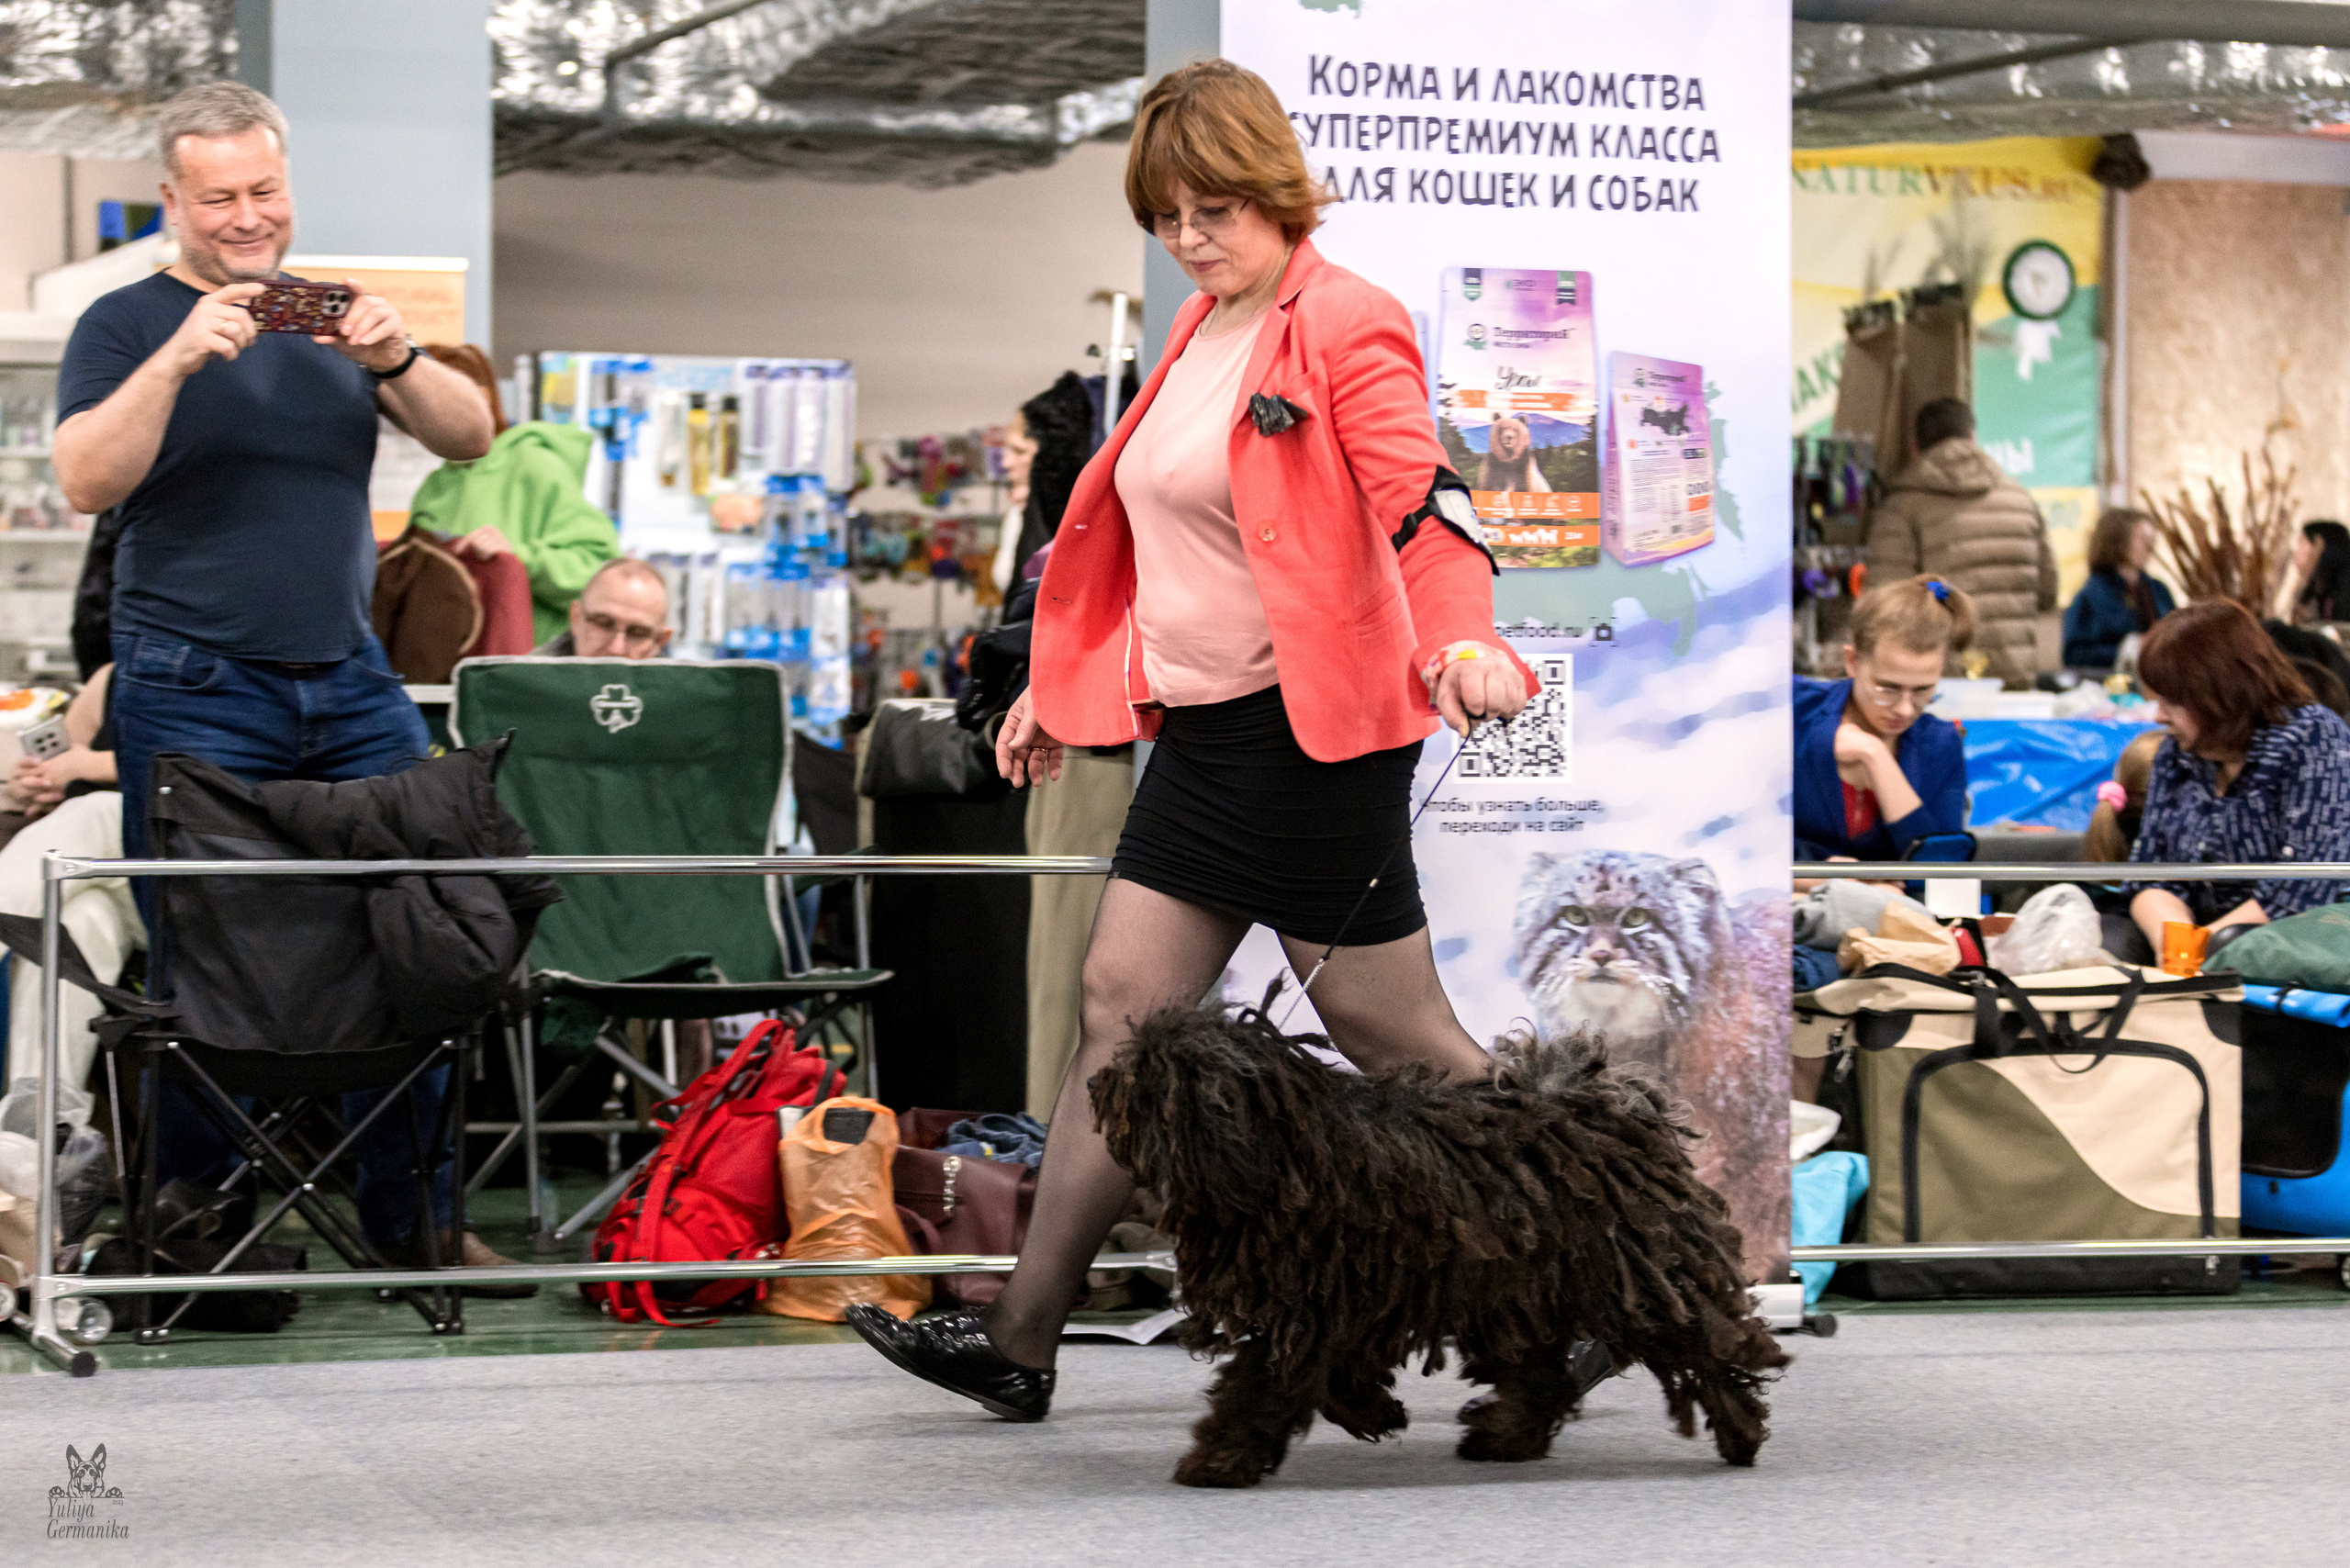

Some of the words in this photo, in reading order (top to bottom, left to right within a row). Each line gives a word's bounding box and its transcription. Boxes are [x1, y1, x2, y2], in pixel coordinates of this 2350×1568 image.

[1454, 67, 1480, 102] И
[1493, 70, 1706, 111] ЛАКОМСТВА
[1591, 124, 1721, 163] КЛАССА
[1408, 169, 1539, 208] КОШЕК
[1551, 174, 1576, 208] И
[1589, 174, 1699, 213] СОБАК
[1476, 800, 1533, 815] узнать
[1535, 797, 1606, 814] больше,
[1439, 822, 1521, 836] переходи
[1524, 822, 1545, 833] на
[1548, 816, 1585, 833] сайт
